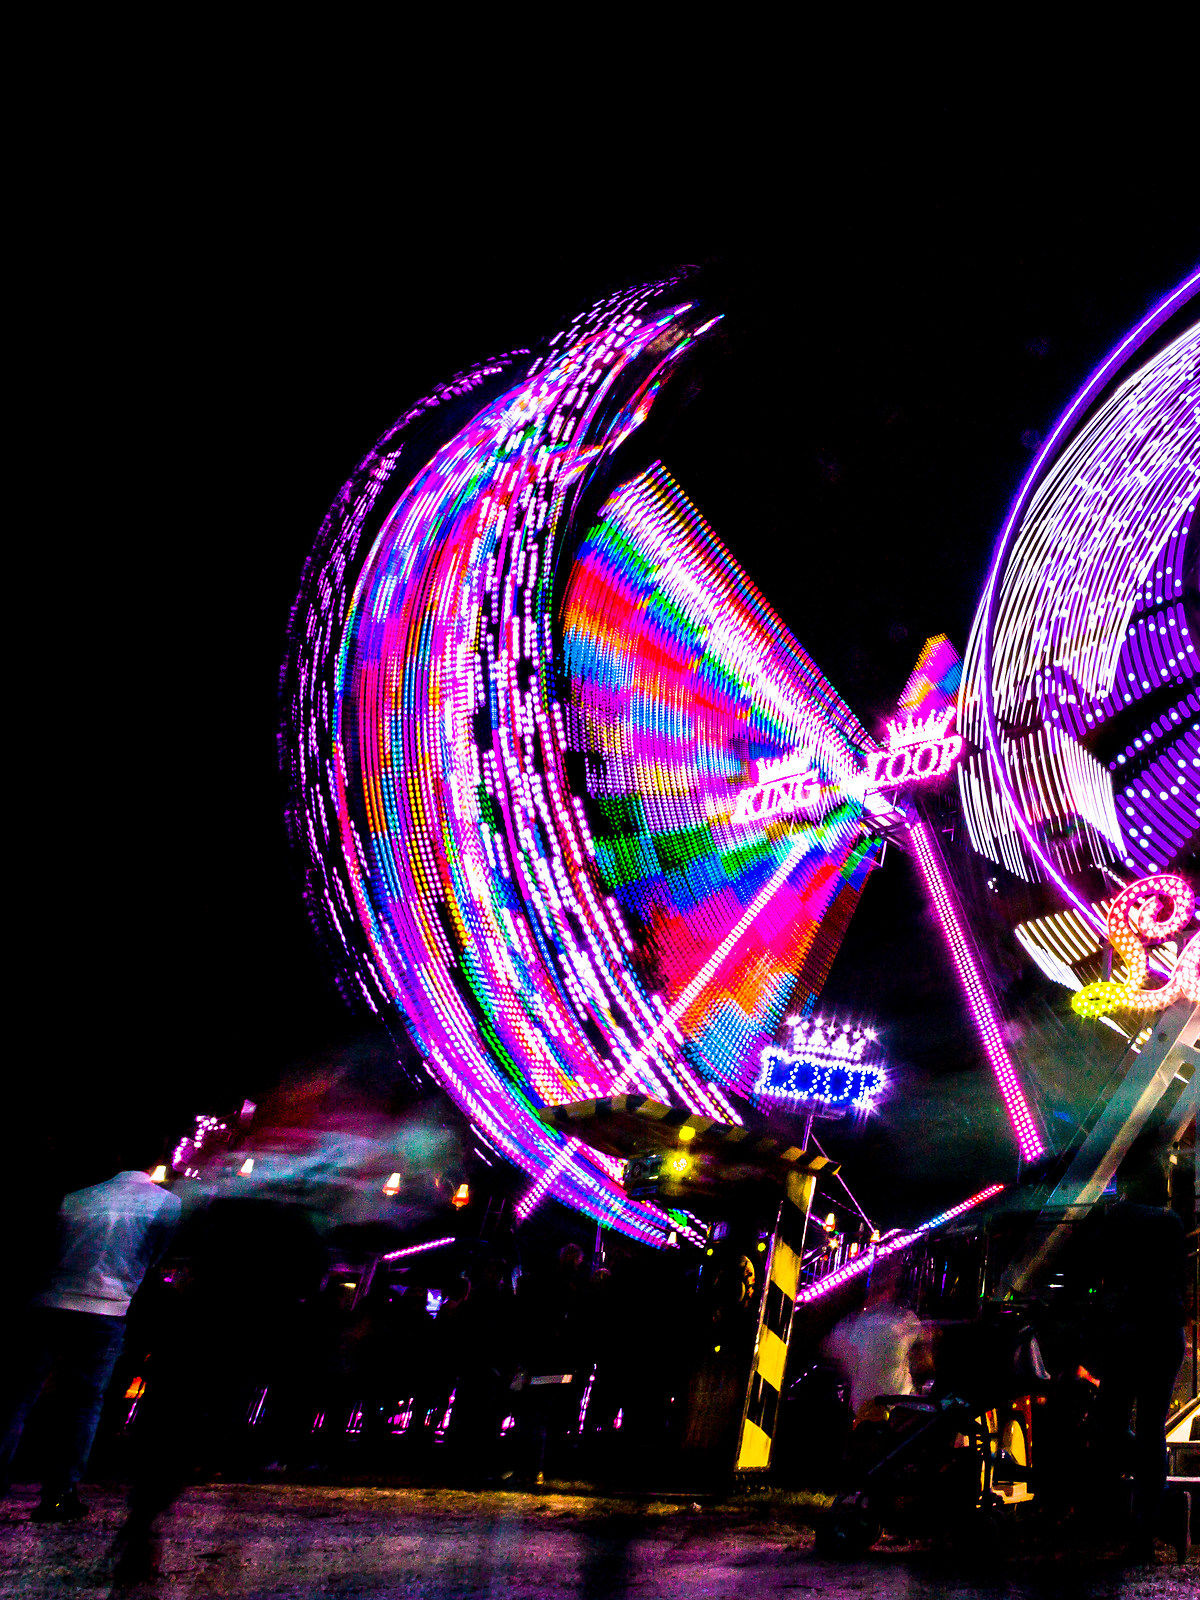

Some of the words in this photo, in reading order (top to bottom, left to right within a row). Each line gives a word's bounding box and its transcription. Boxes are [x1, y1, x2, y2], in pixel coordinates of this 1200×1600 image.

[731, 768, 821, 824] KING
[864, 734, 962, 788] LOOP
[754, 1046, 887, 1110] LOOP
